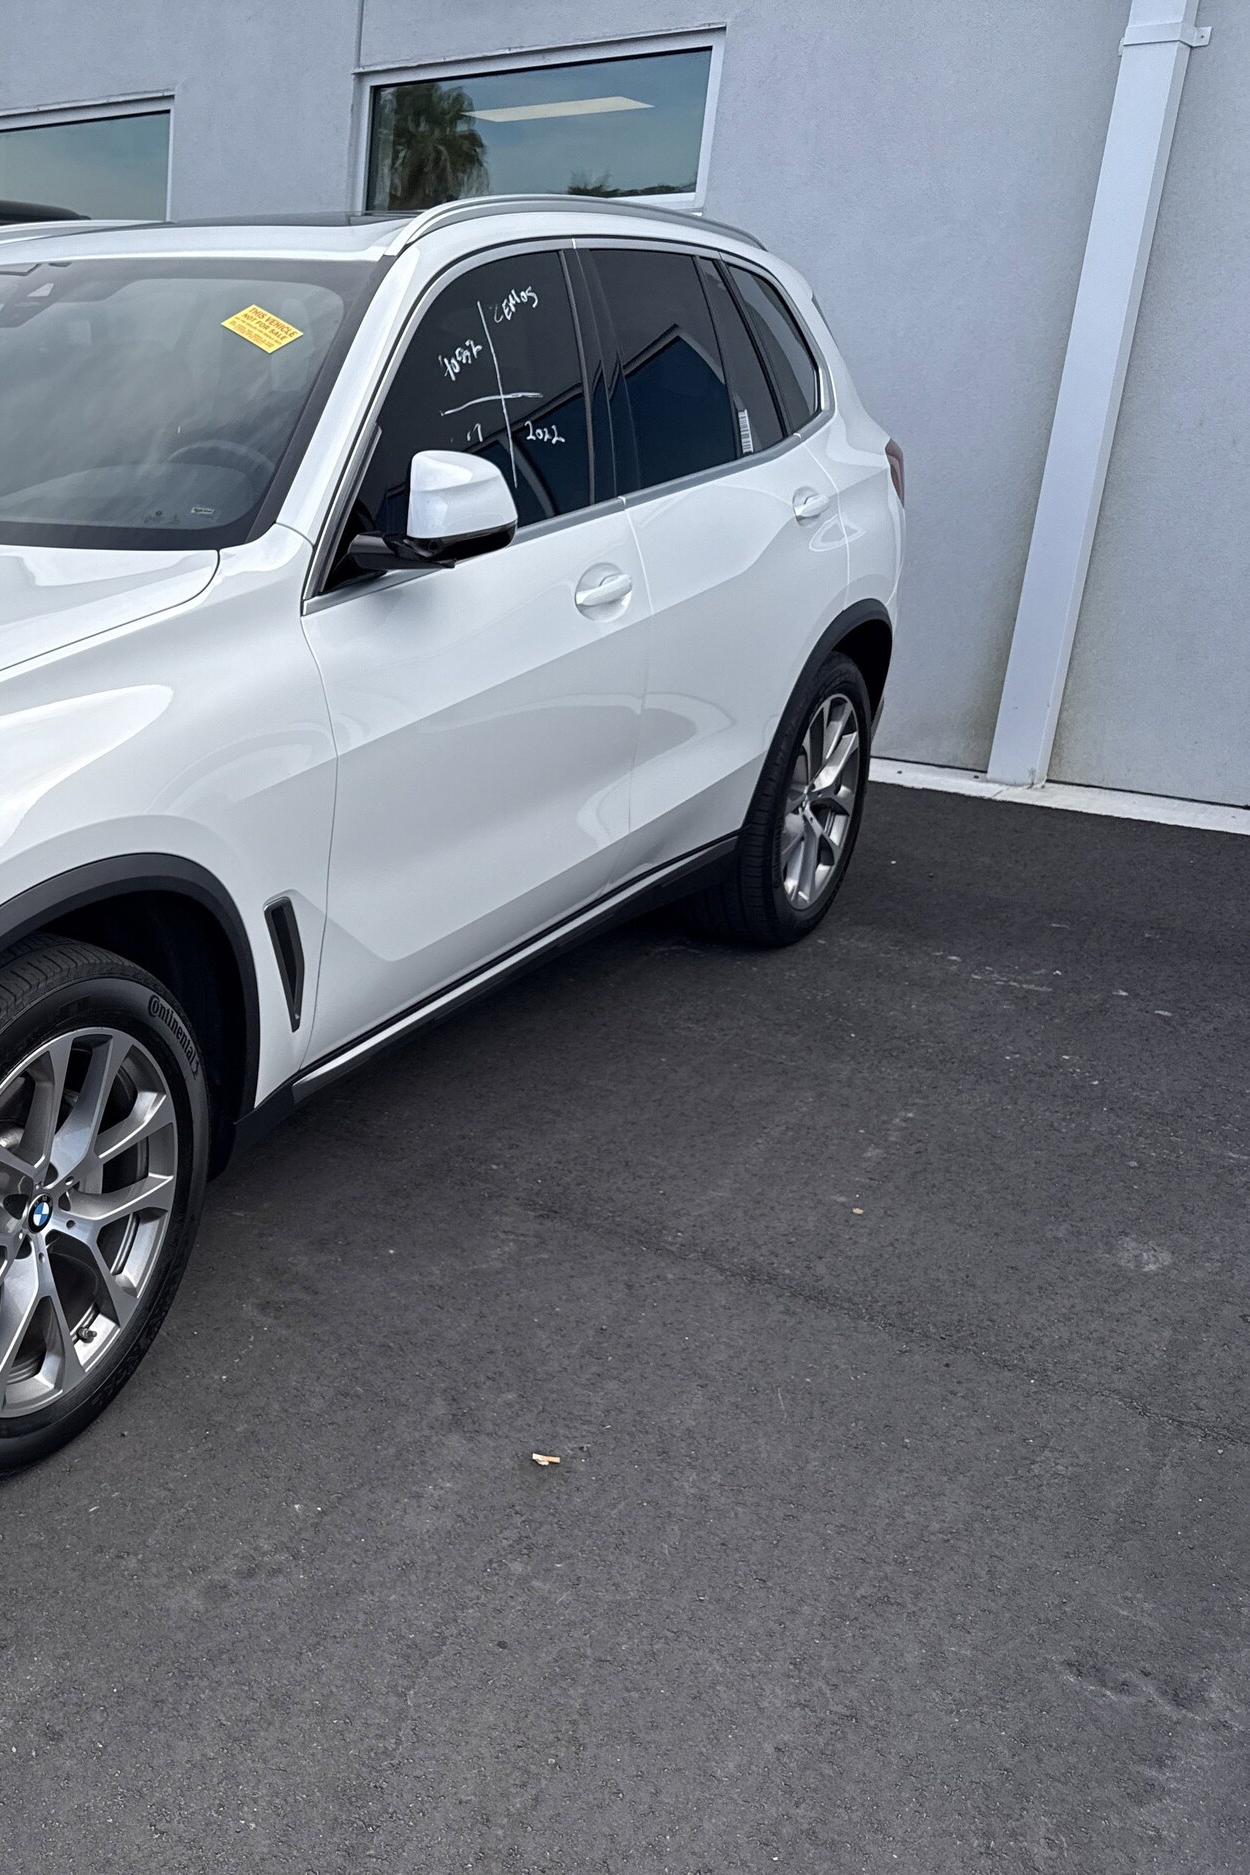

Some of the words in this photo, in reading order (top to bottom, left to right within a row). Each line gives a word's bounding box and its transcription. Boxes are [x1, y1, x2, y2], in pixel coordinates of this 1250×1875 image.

[242, 313, 257, 322] NOT
[255, 320, 270, 331] FOR
[269, 328, 287, 341] SALE
[249, 307, 268, 320] THIS
[265, 316, 298, 338] VEHICLE
[148, 995, 196, 1066] Continental
